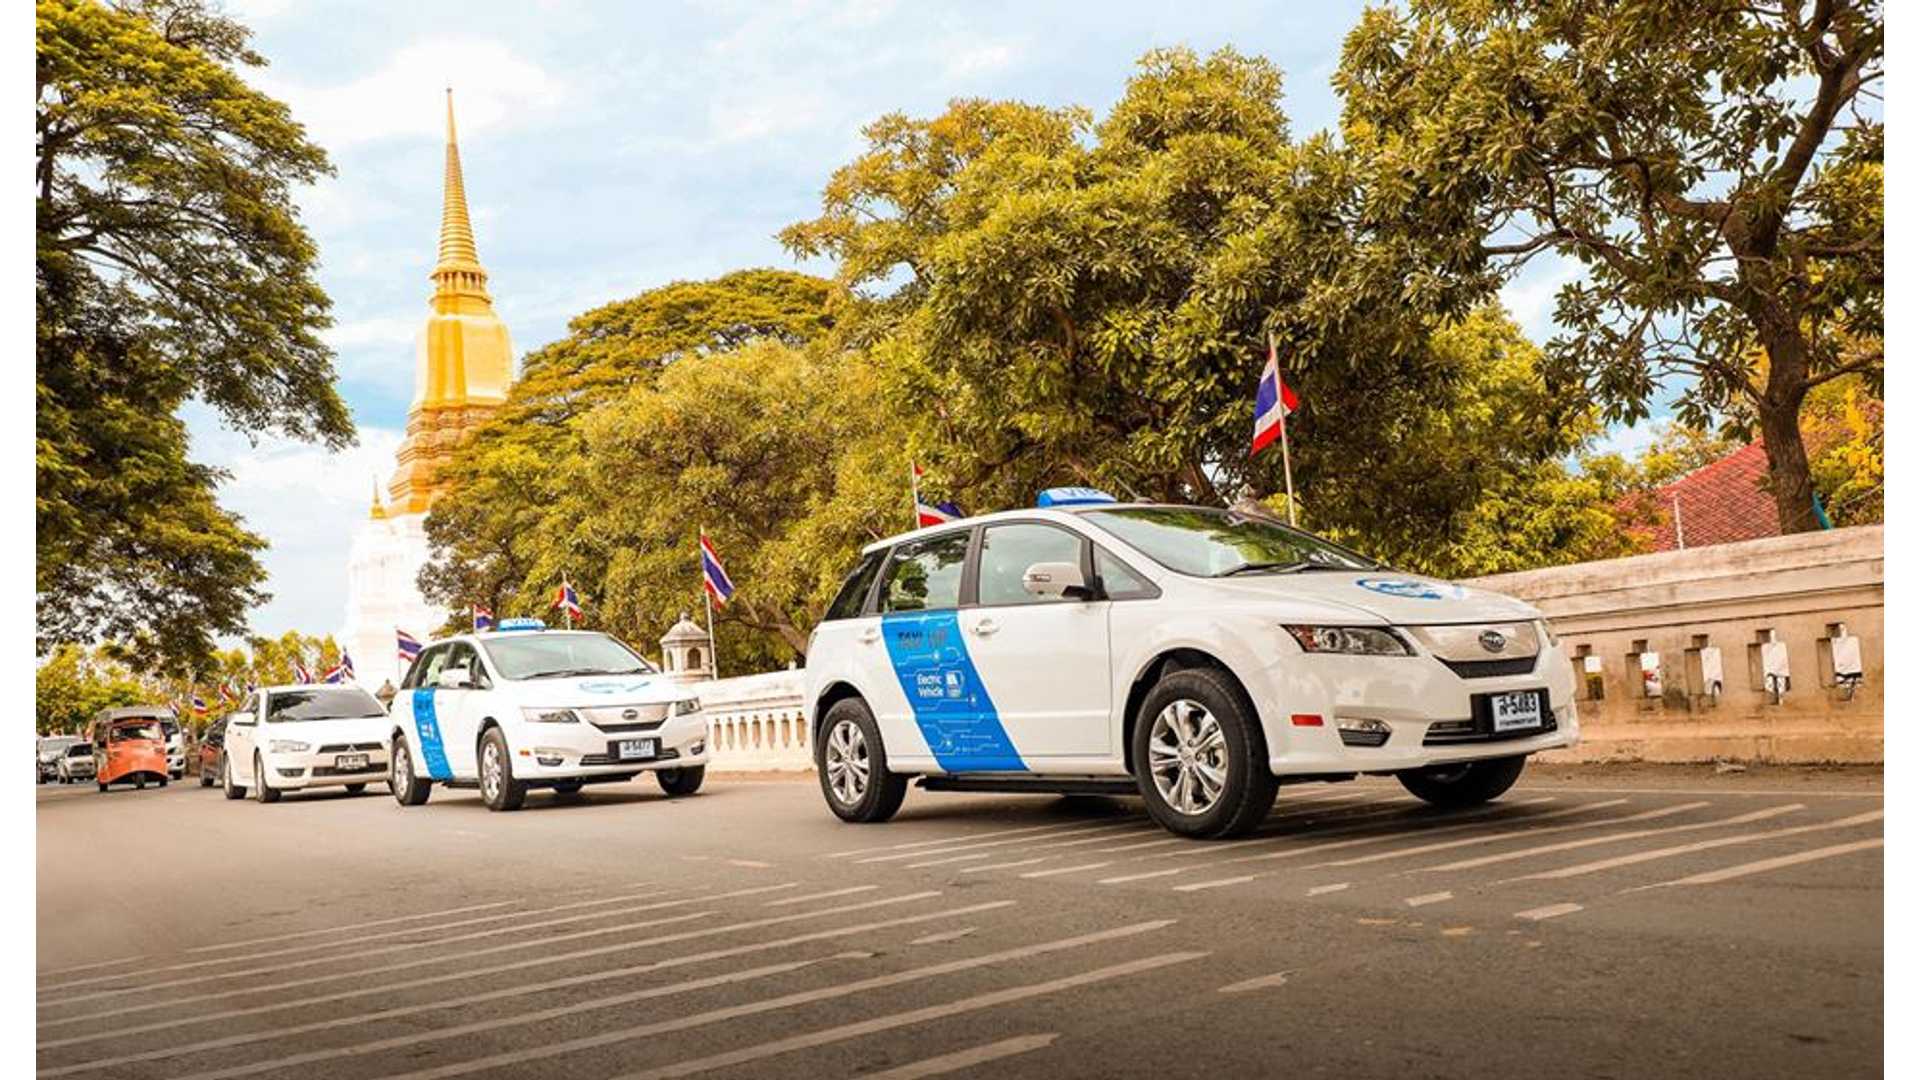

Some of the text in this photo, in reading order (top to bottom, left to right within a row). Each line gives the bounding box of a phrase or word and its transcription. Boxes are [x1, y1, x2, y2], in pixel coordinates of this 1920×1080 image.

[897, 630, 923, 648] TAXI
[917, 673, 943, 687] Electric
[918, 686, 944, 698] Vehicle
